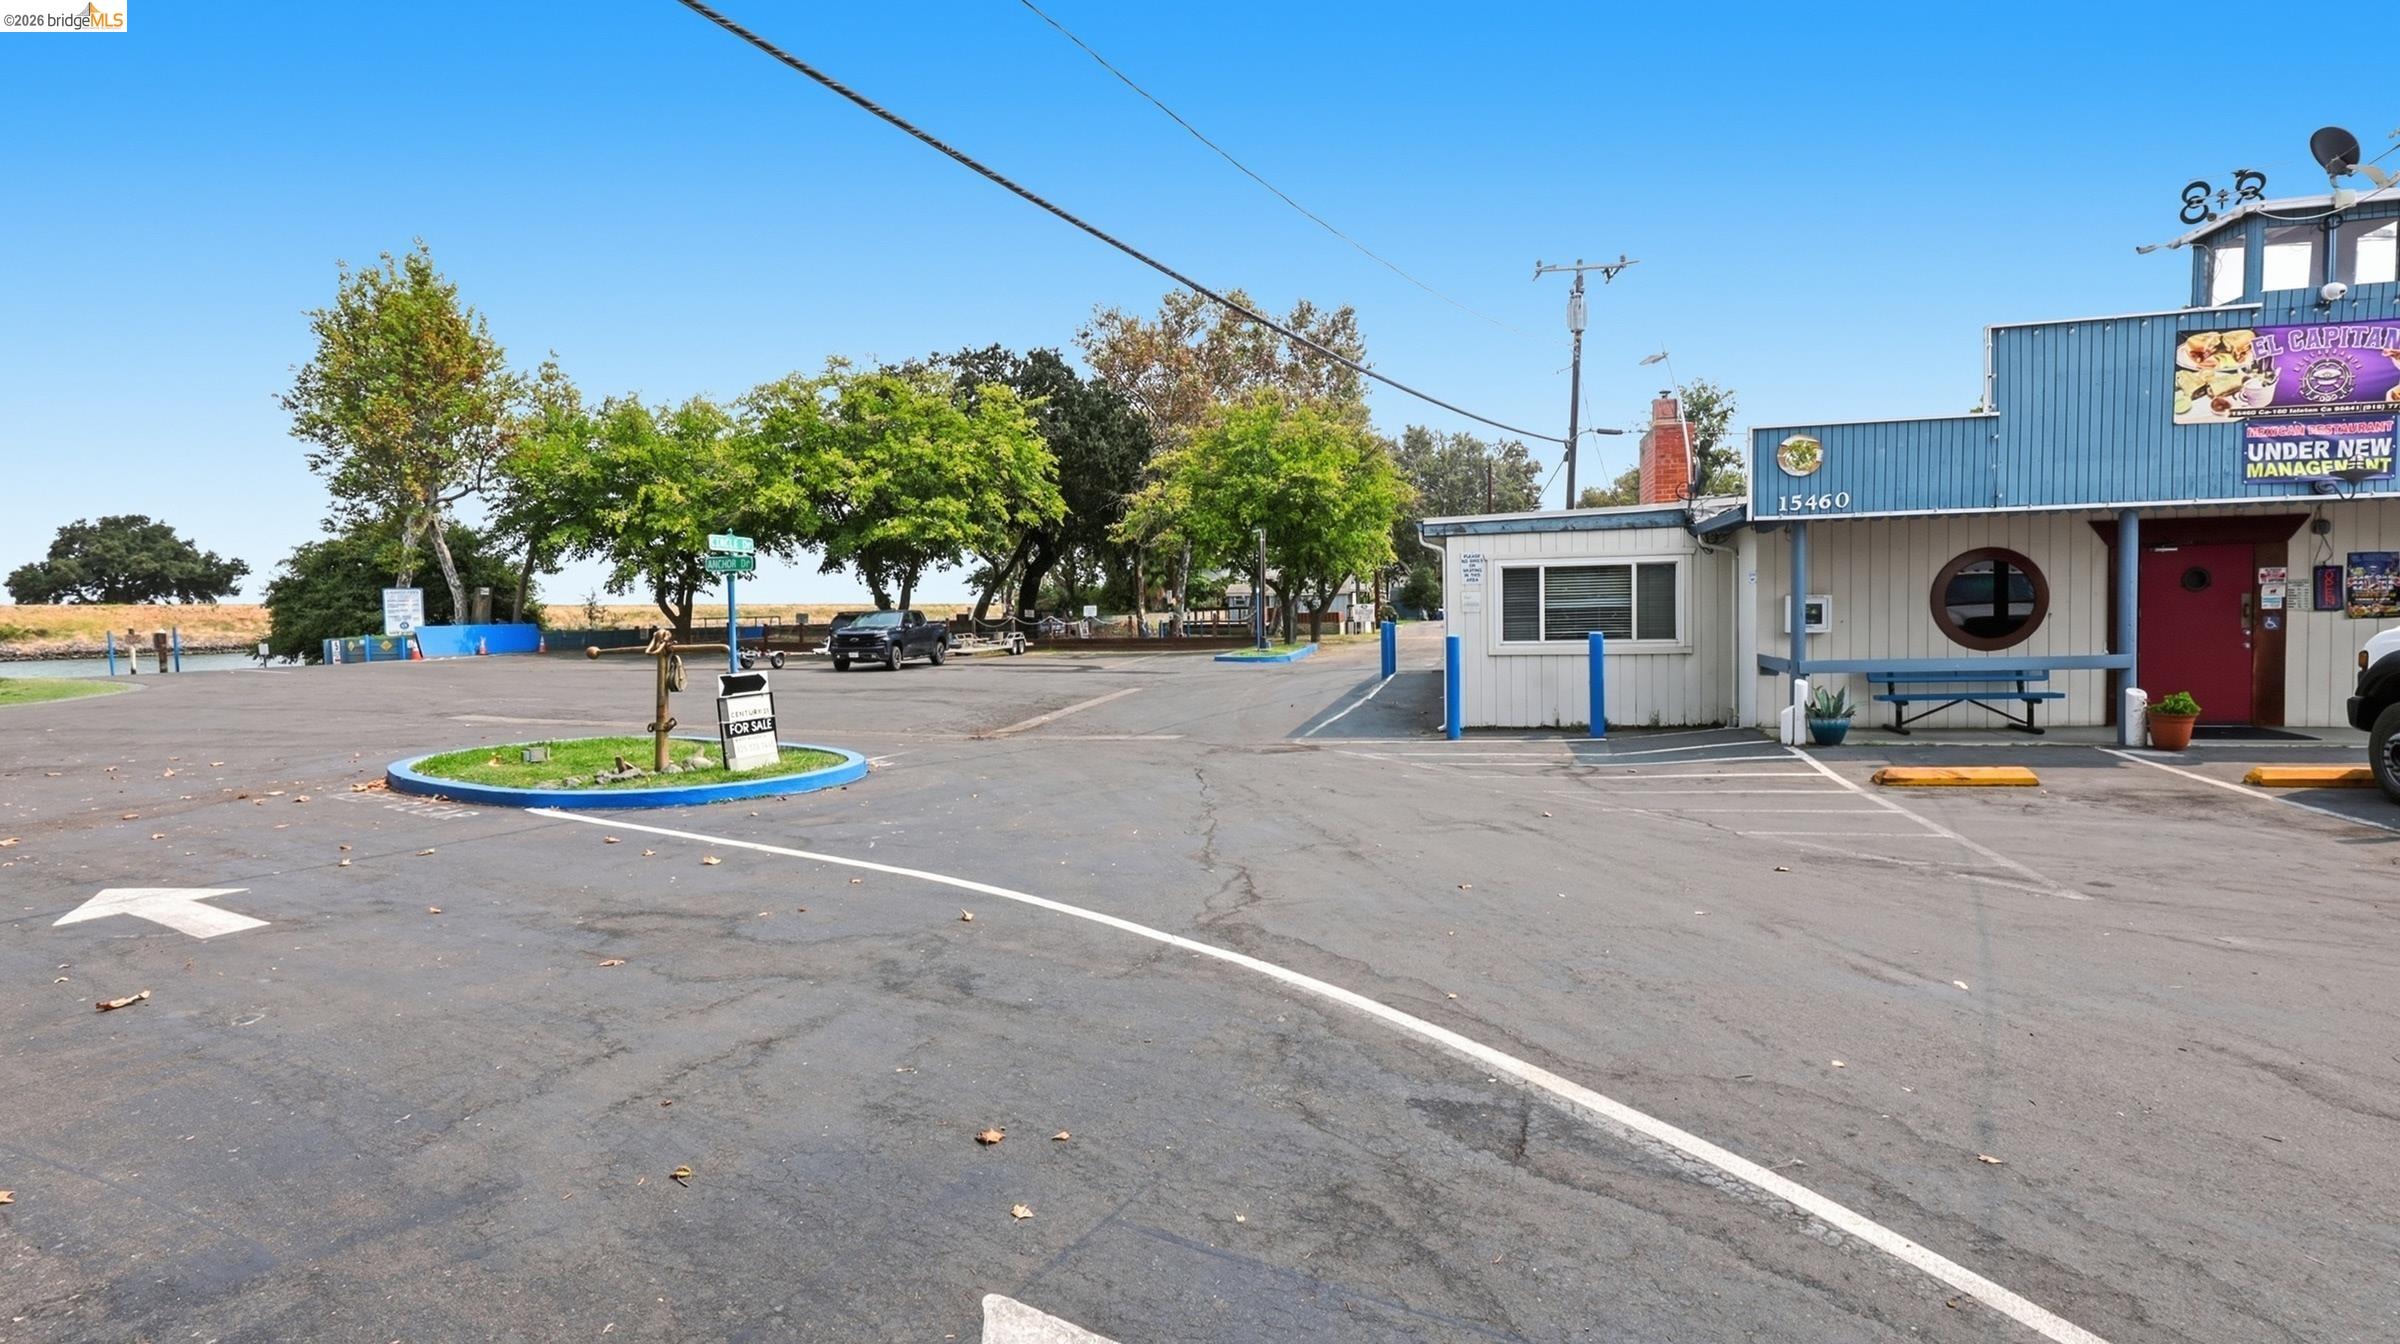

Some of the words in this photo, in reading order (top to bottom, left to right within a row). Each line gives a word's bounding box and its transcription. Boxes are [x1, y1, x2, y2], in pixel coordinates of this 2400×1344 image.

[2251, 335, 2284, 360] EL
[2288, 326, 2400, 352] CAPITAN
[2246, 424, 2305, 438] MEXICAN
[2307, 420, 2394, 435] RESTAURANT
[2248, 440, 2330, 462] UNDER
[2337, 438, 2392, 458] NEW
[2247, 457, 2392, 478] MANAGEMNT
[1779, 492, 1849, 511] 15460
[708, 559, 737, 570] ANCHOR
[730, 722, 750, 735] FOR
[751, 719, 772, 732] SALE
